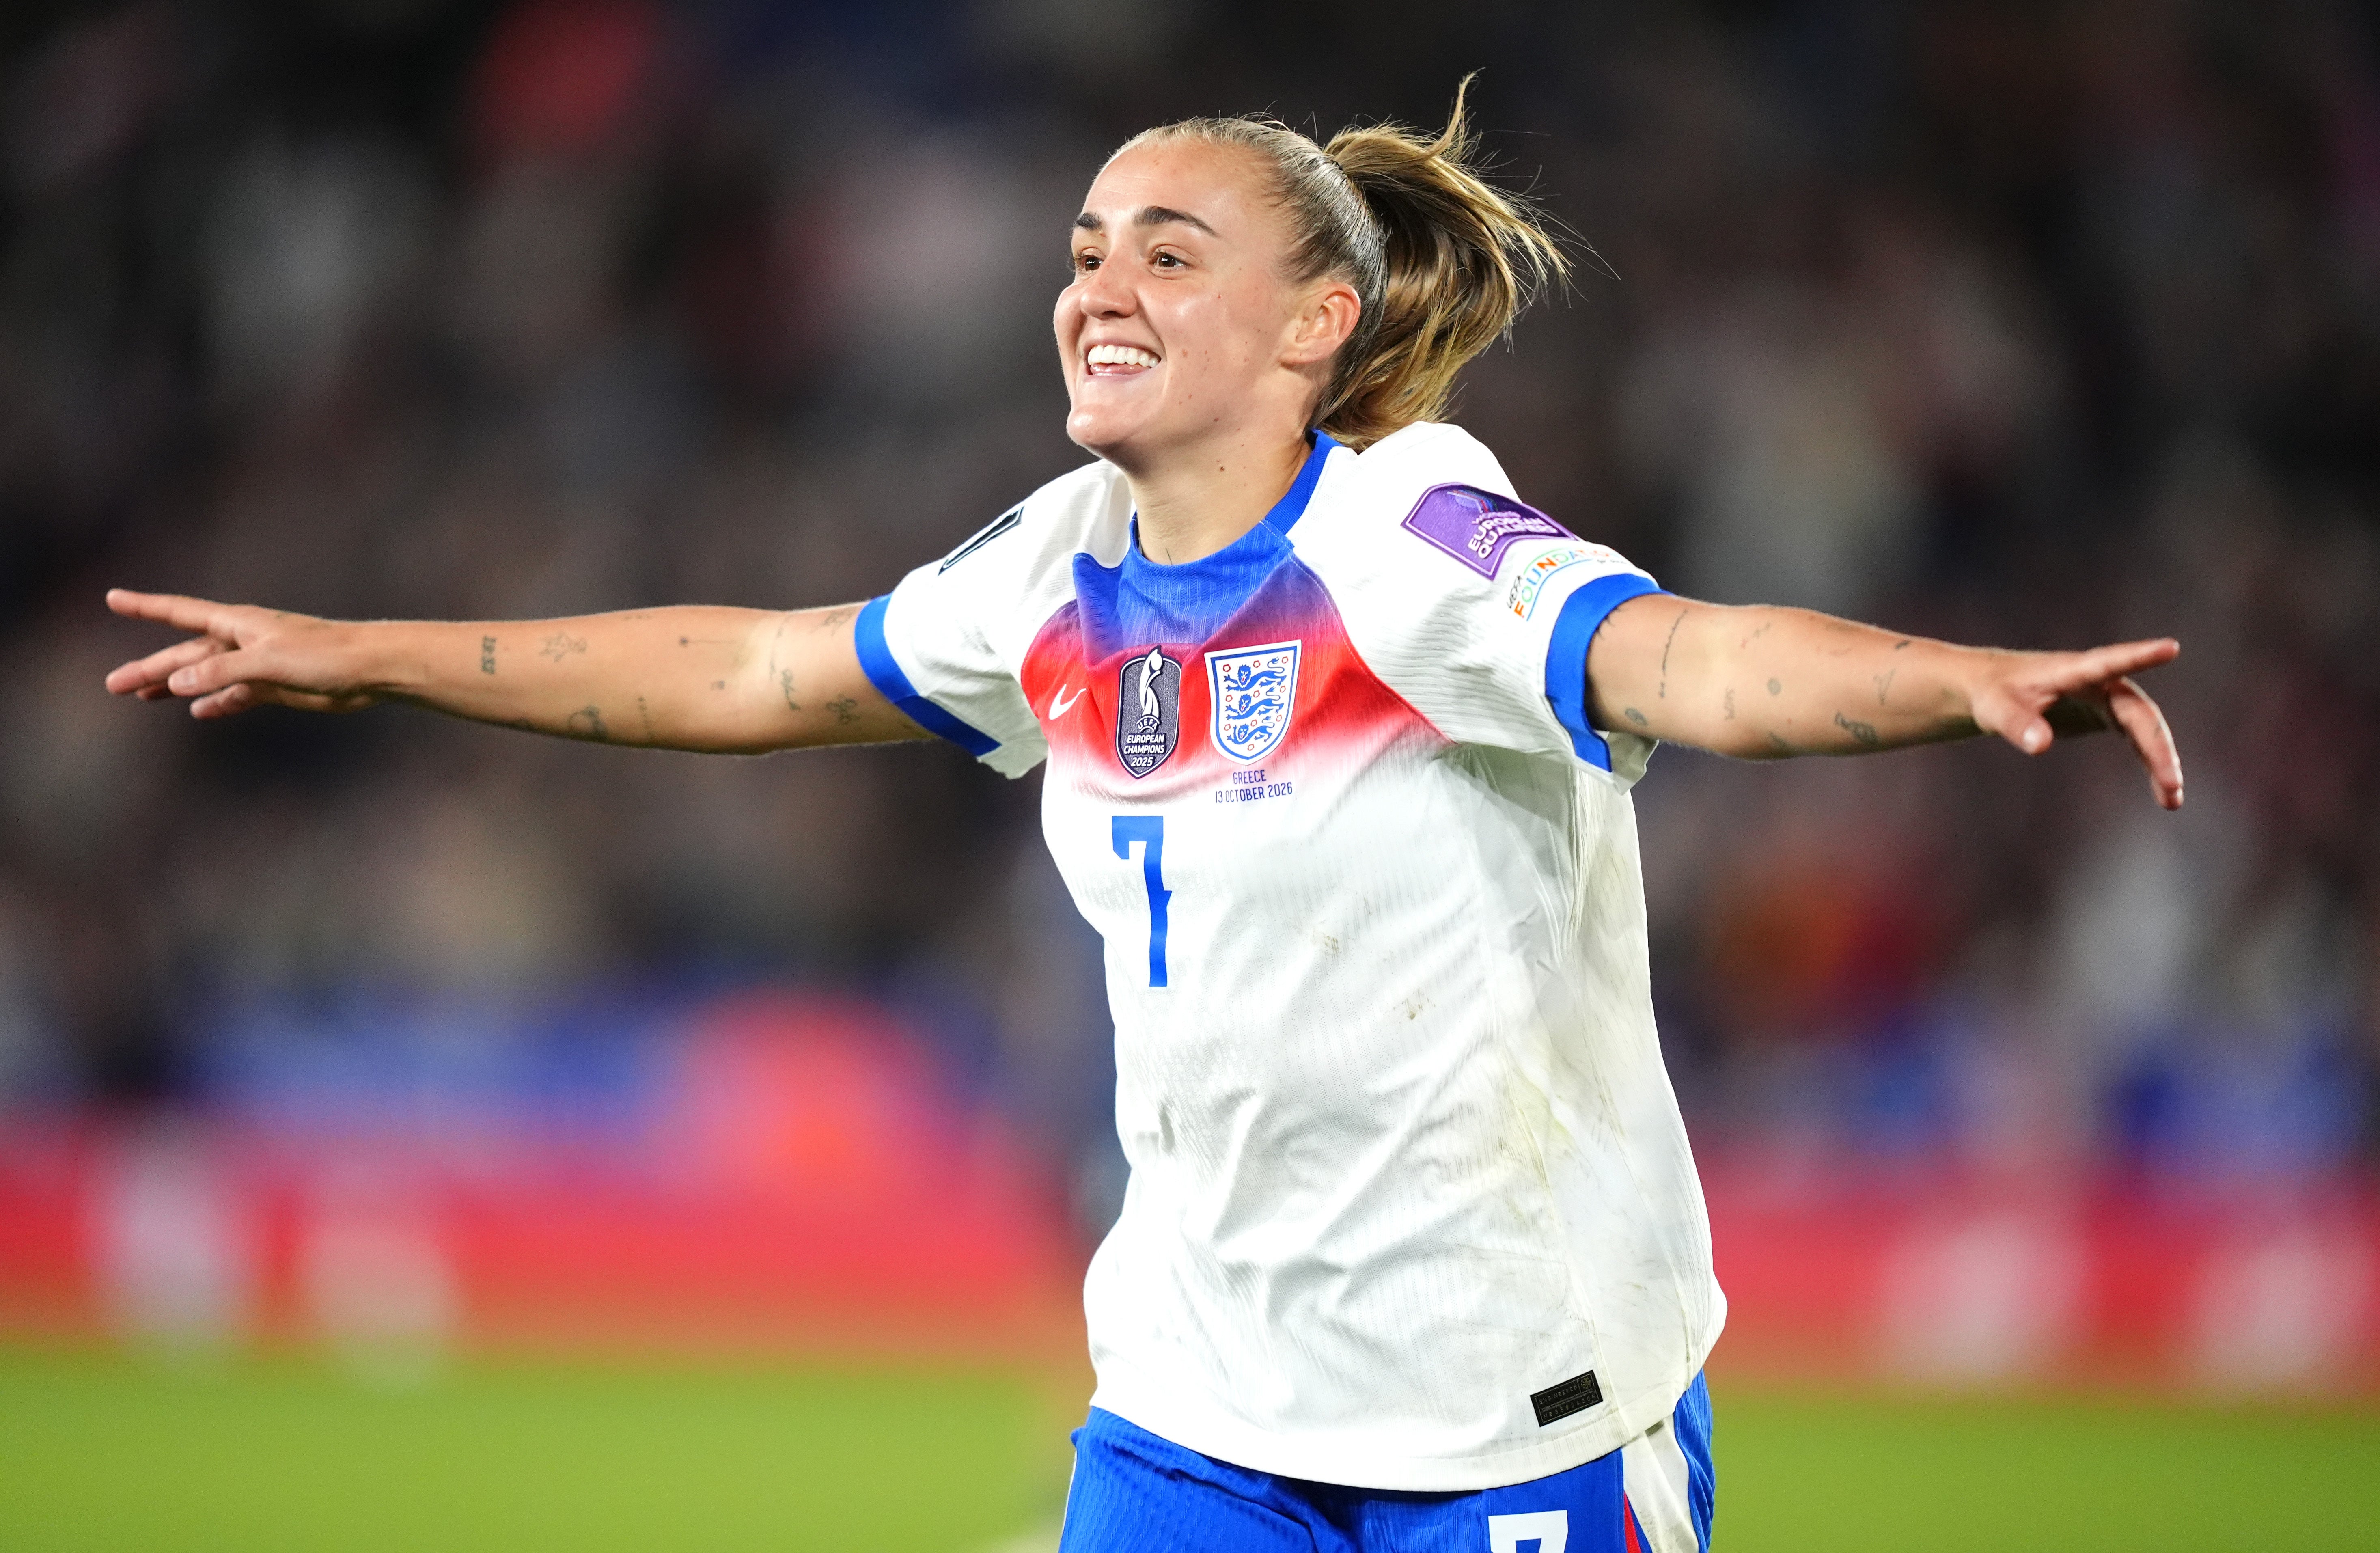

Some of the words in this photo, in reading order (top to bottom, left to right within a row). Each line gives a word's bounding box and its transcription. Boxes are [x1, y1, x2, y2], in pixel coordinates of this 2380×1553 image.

[1514, 549, 1616, 618] FOUNDATO
[1507, 575, 1523, 609] UEFA
[1137, 718, 1158, 730] UEFA
[1127, 734, 1164, 744] EUROPEAN
[1124, 745, 1164, 754] CHAMPIONS
[1131, 757, 1153, 767] 2025
[1233, 770, 1267, 785] GREECE
[1216, 791, 1223, 803] 13
[1225, 787, 1265, 802] OCTOBER
[1268, 782, 1292, 798] 2026
[1112, 815, 1172, 987] 7
